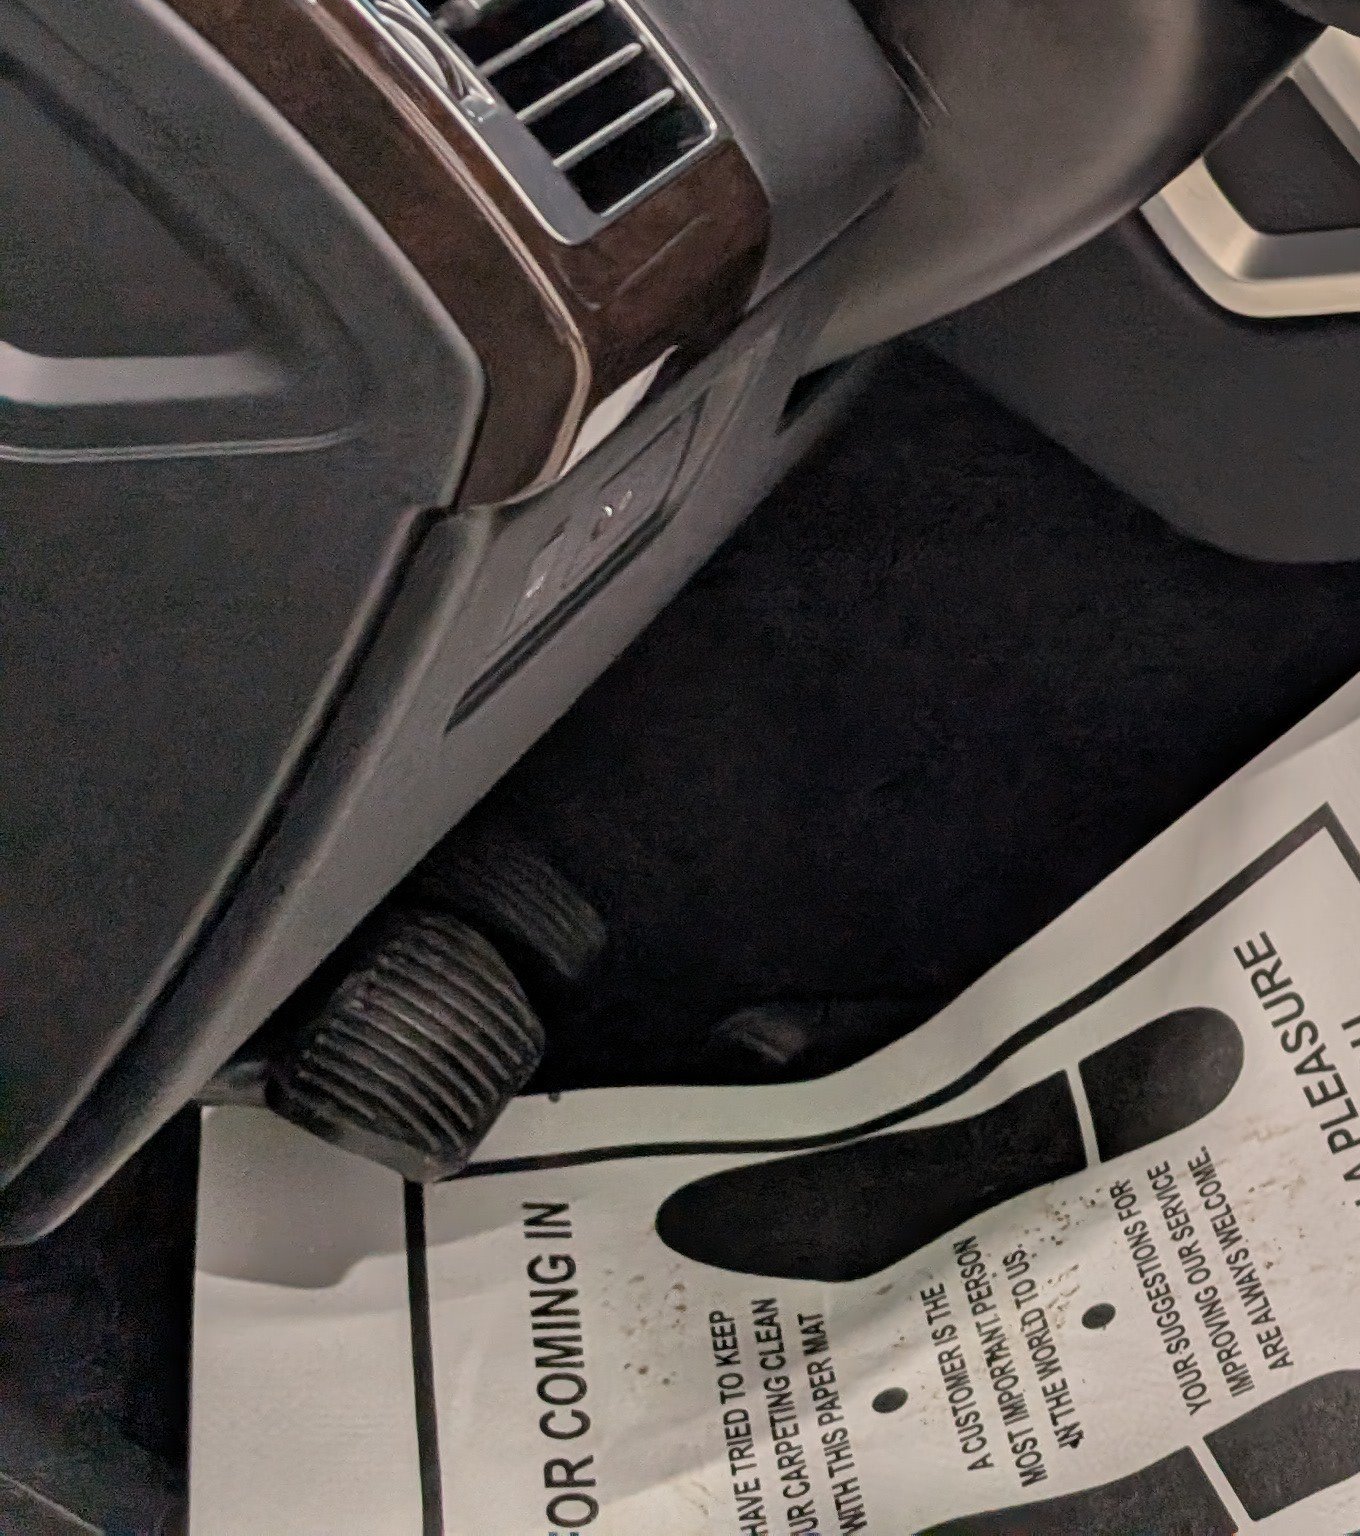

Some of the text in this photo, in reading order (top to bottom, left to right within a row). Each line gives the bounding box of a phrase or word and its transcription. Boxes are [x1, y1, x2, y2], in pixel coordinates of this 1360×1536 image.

[523, 1201, 599, 1536] OR COMING IN
[953, 1236, 1048, 1487] MOST IMPORTANT PERSON
[1002, 1243, 1083, 1449] IN THE WORLD TO US.
[1110, 1179, 1211, 1415] YOUR SUGGESTIONS FOR
[1147, 1160, 1255, 1396] IMPROVING OUR SERVICE
[1188, 1146, 1294, 1370] ARE ALWAYS WELCOME.
[709, 1310, 768, 1536] HAVE TRIED TO KEEP
[751, 1297, 819, 1536] UR CARPETING CLEAN
[797, 1313, 867, 1536] WITH THIS PAPER MAT
[921, 1282, 994, 1470] A CUSTOMER IS THE
